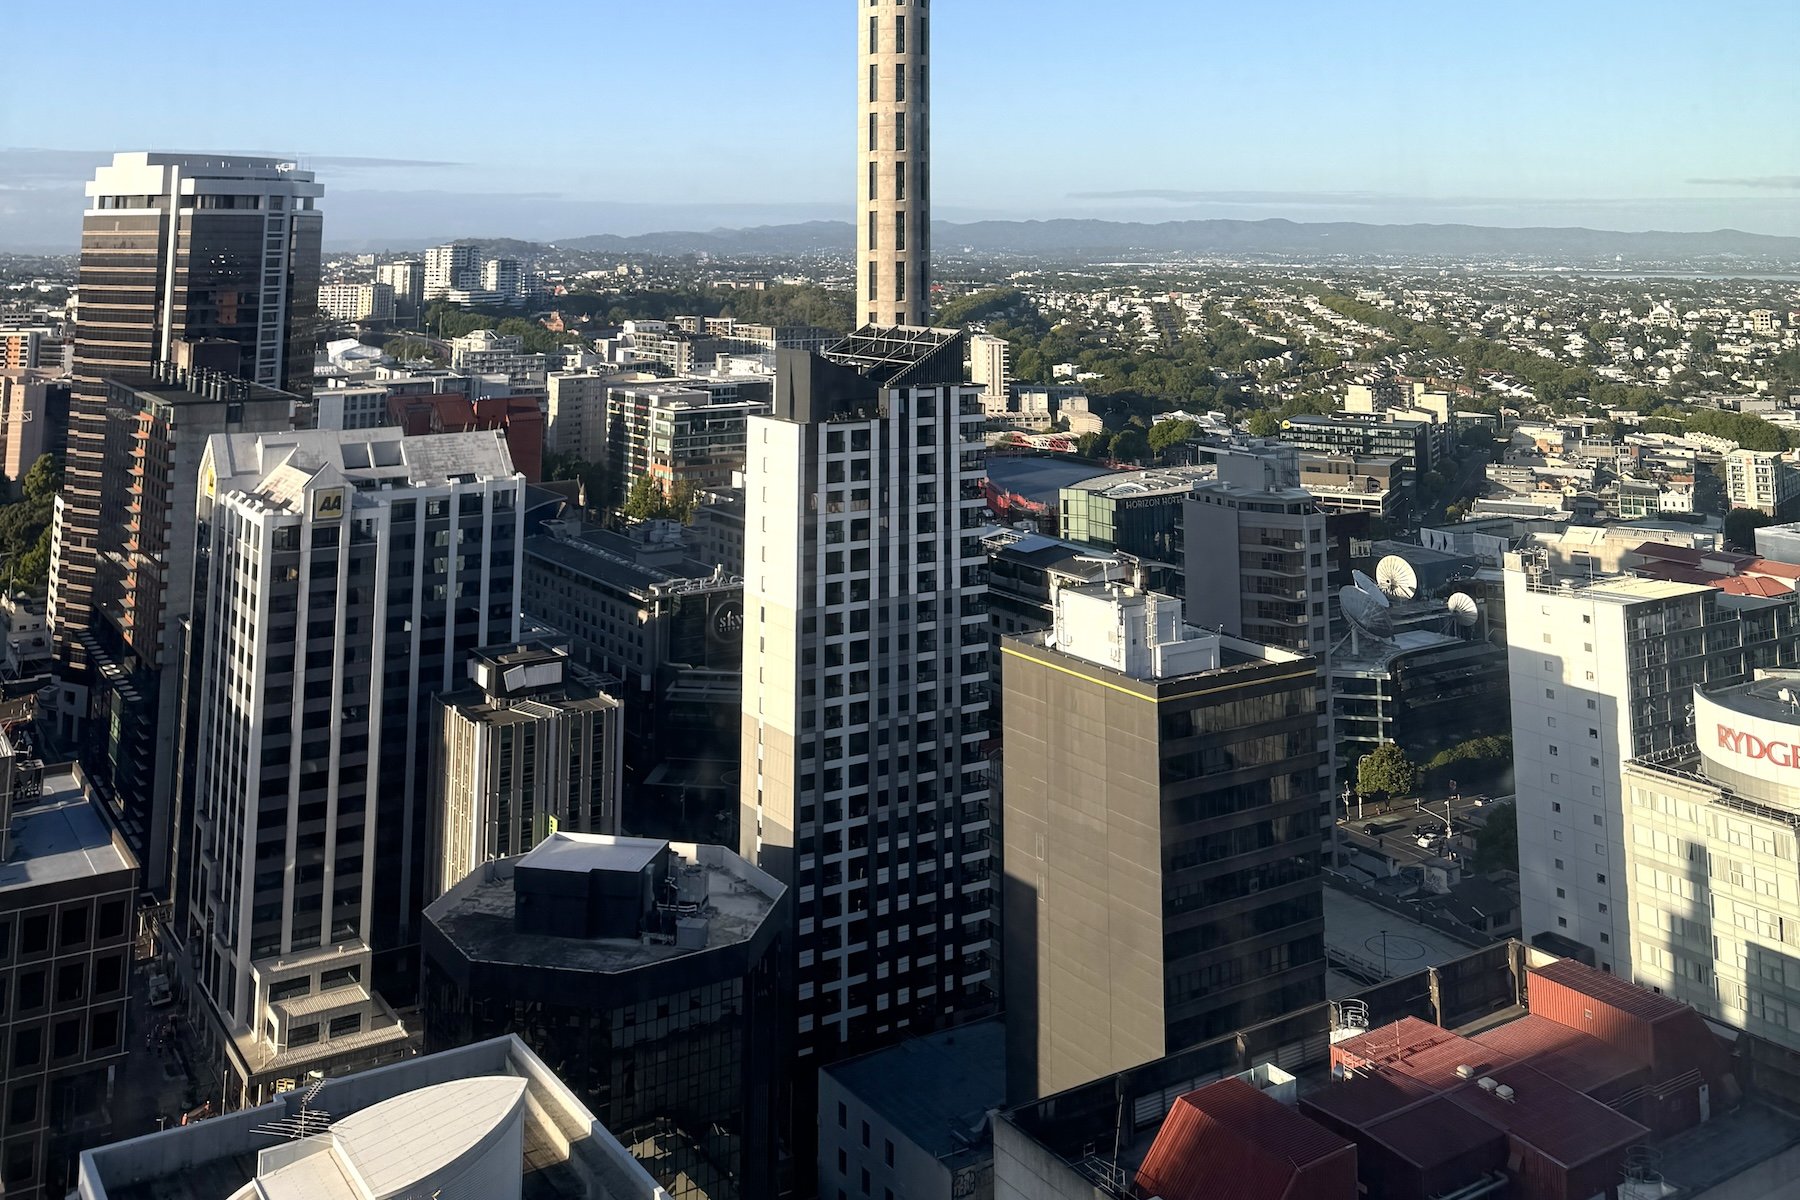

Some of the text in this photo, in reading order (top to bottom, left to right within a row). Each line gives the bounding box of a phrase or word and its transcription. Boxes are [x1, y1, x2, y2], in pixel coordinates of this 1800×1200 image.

[319, 496, 341, 511] AA
[1125, 495, 1183, 509] HORIZON HOTEL
